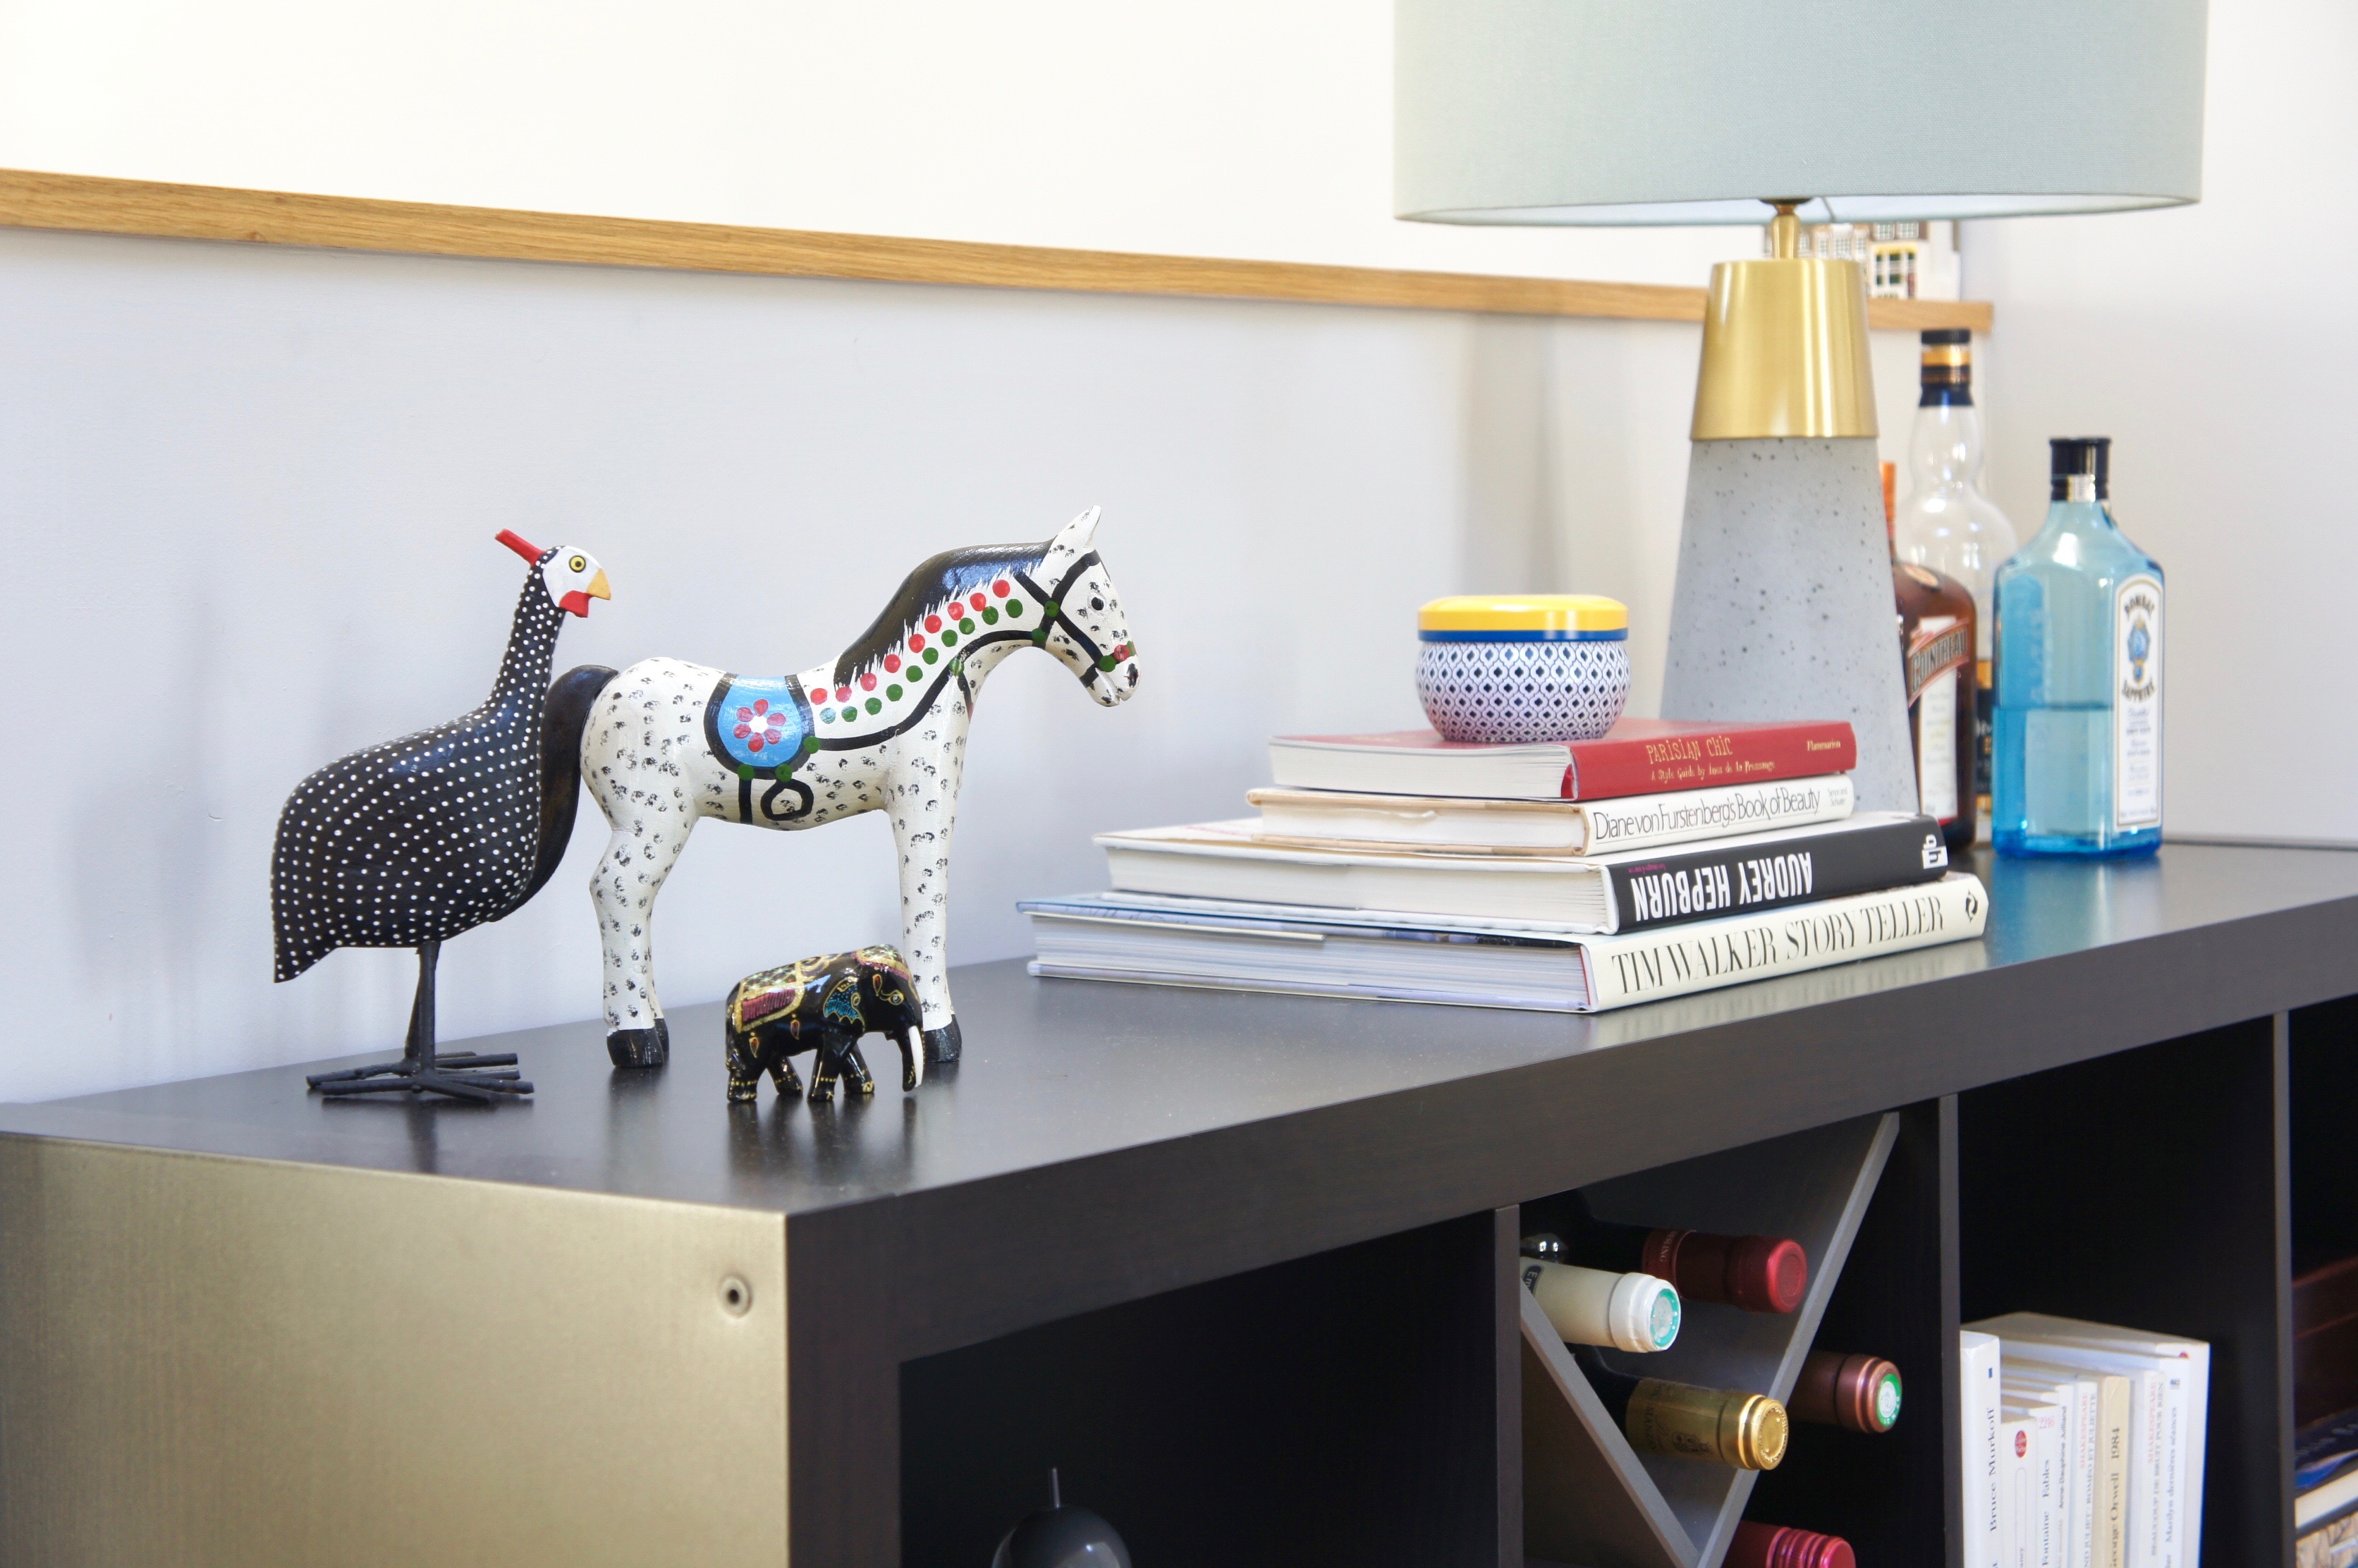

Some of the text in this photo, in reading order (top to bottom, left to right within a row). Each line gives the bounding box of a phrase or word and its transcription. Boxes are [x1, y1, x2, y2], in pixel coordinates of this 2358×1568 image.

[1912, 629, 1967, 693] COINTREAU
[1658, 769, 1675, 783] Style
[1678, 767, 1695, 780] Guide
[1697, 766, 1705, 780] by
[1725, 761, 1733, 773] de
[1807, 740, 1841, 752] Flammarion
[1594, 788, 1821, 840] Diane von Furstenberg's Book of Beauty
[1630, 852, 1813, 922] AUDREY HEPBURN
[1611, 895, 1945, 995] TIM WALKER STORY TELLER
[2079, 1392, 2089, 1470] SHAKESPEARE
[2110, 1427, 2120, 1459] 1984
[2148, 1382, 2157, 1464] SHAKESPEARE
[1986, 1407, 1998, 1533] Bruce Murkoff
[2058, 1441, 2067, 1509] Anne-Dauphine
[2110, 1472, 2120, 1521] Orwell
[2041, 1459, 2051, 1566] Fontaine Fables
[2165, 1499, 2175, 1543] Marilyn
